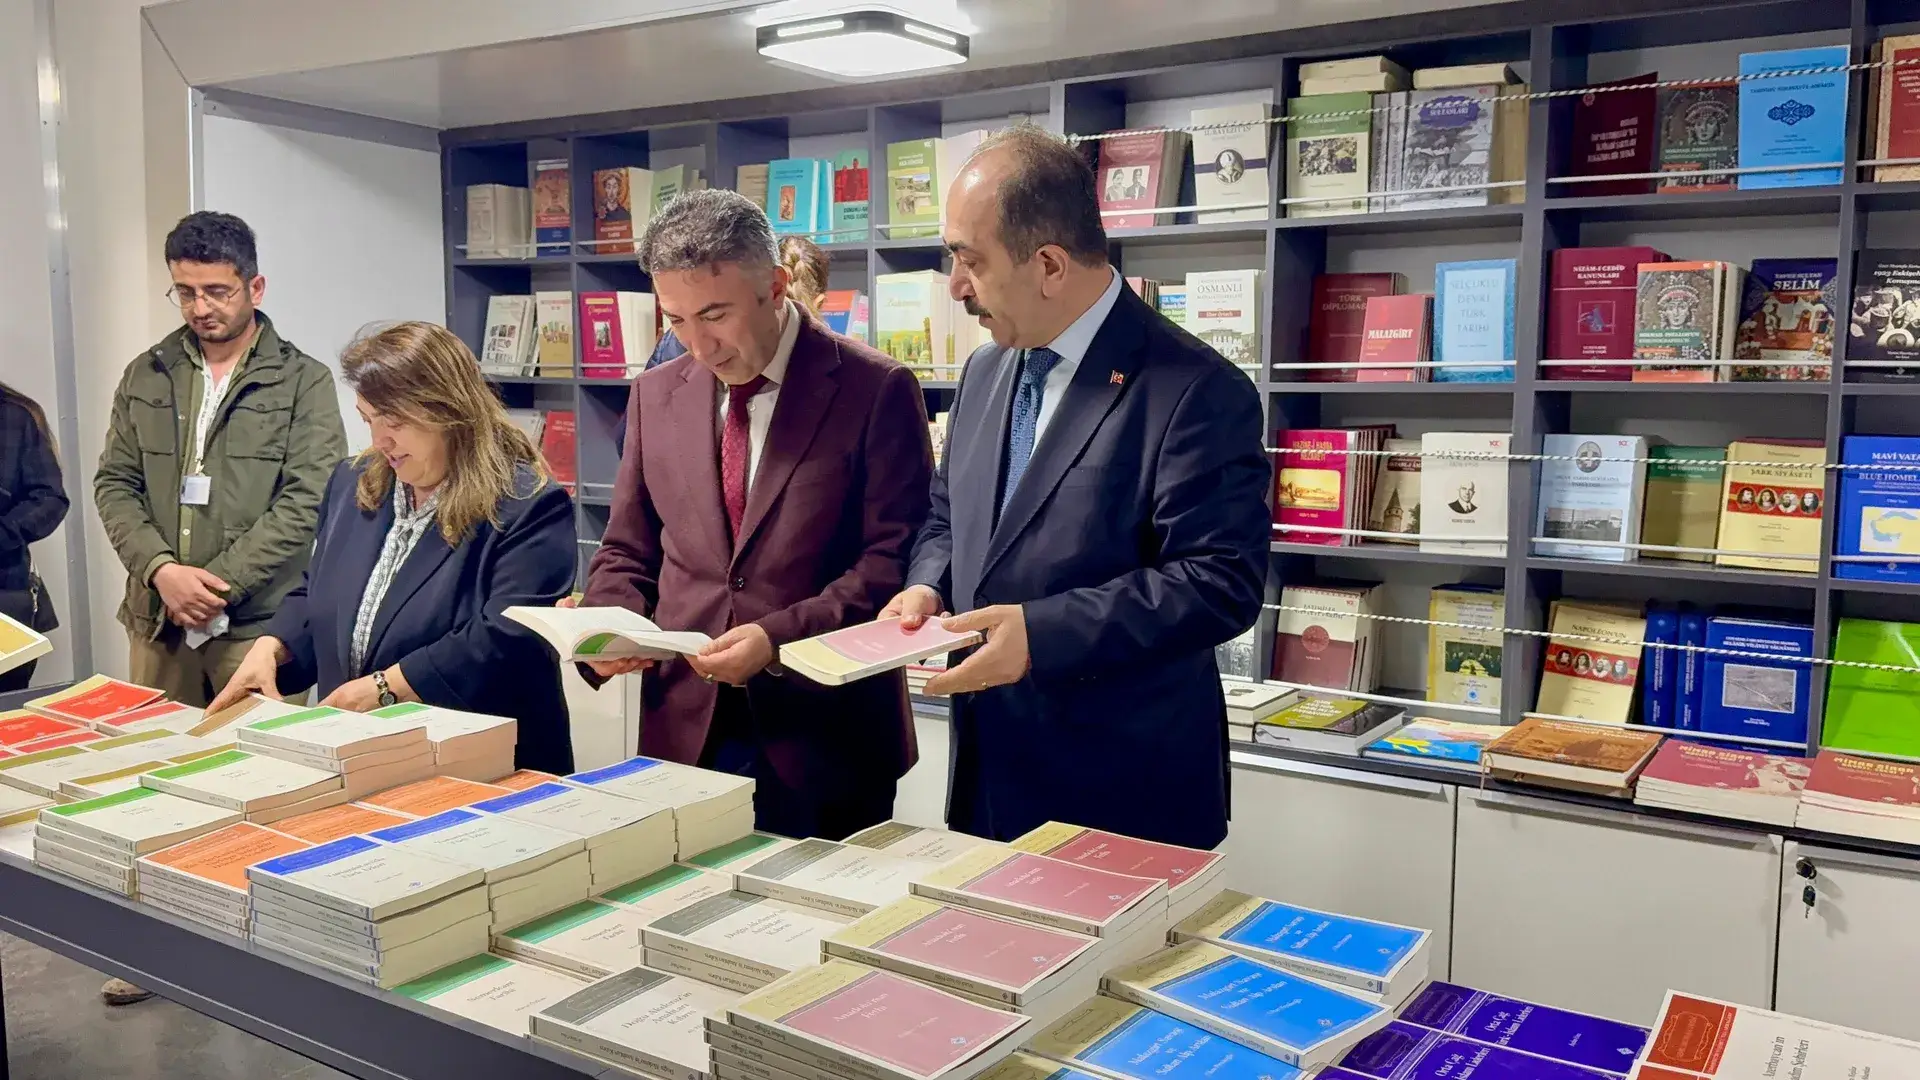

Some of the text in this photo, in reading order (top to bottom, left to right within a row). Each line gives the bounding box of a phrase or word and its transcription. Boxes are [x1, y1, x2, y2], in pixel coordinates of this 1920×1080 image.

[1197, 284, 1243, 293] OSMANLI
[1773, 279, 1820, 291] SELİM
[1368, 328, 1413, 339] MALAZGİRT
[1871, 451, 1897, 460] MAVİ
[1885, 473, 1920, 482] HOMEL
